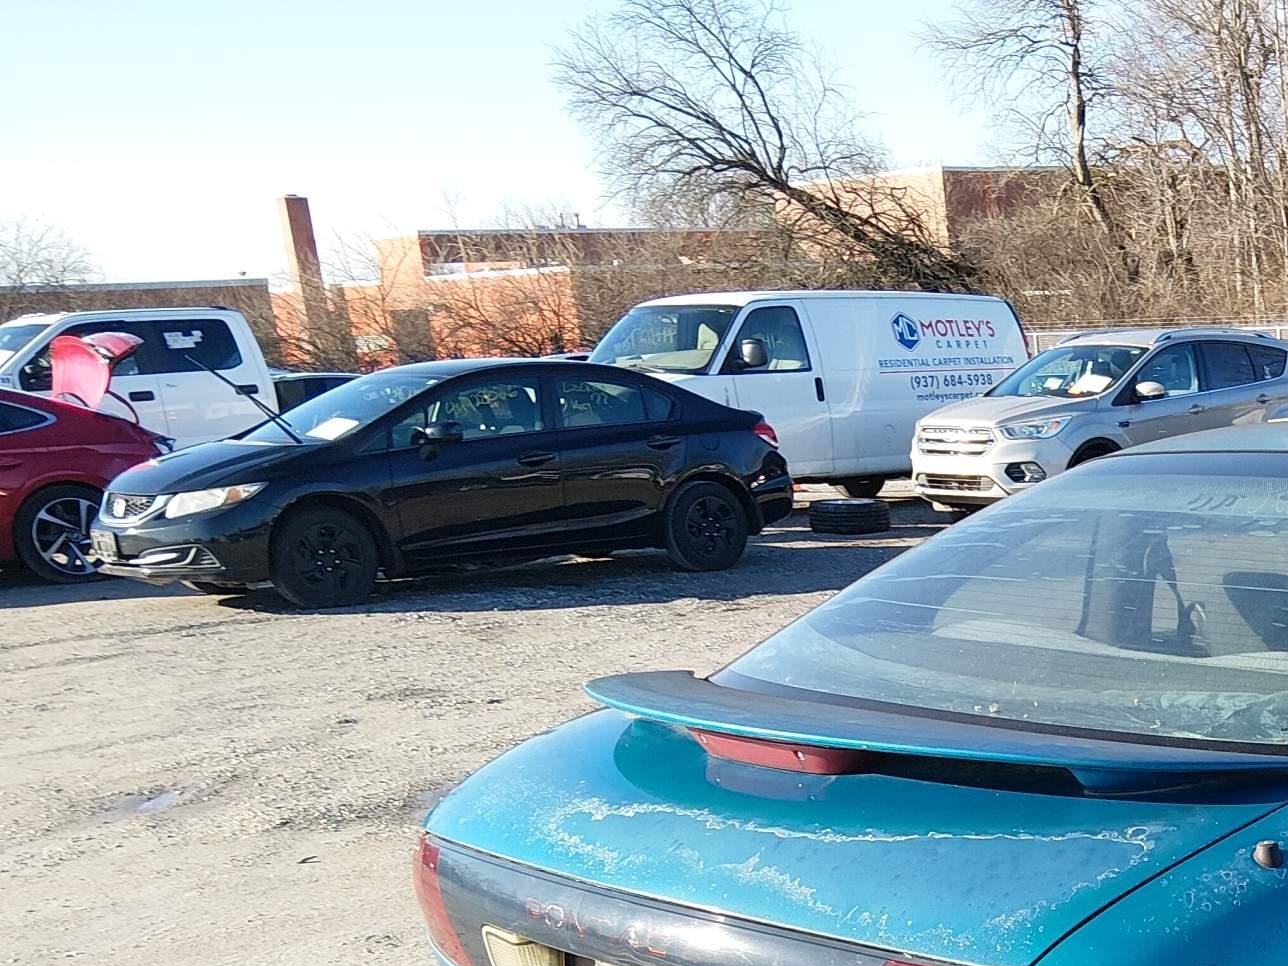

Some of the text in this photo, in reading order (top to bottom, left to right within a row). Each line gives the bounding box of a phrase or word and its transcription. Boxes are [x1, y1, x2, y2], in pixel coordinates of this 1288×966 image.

[918, 319, 995, 338] MOTLEY'S
[935, 340, 988, 349] CARPET
[878, 355, 1014, 368] RESIDENTIAL CARPET INSTALLATION
[910, 373, 993, 390] (937) 684-5938
